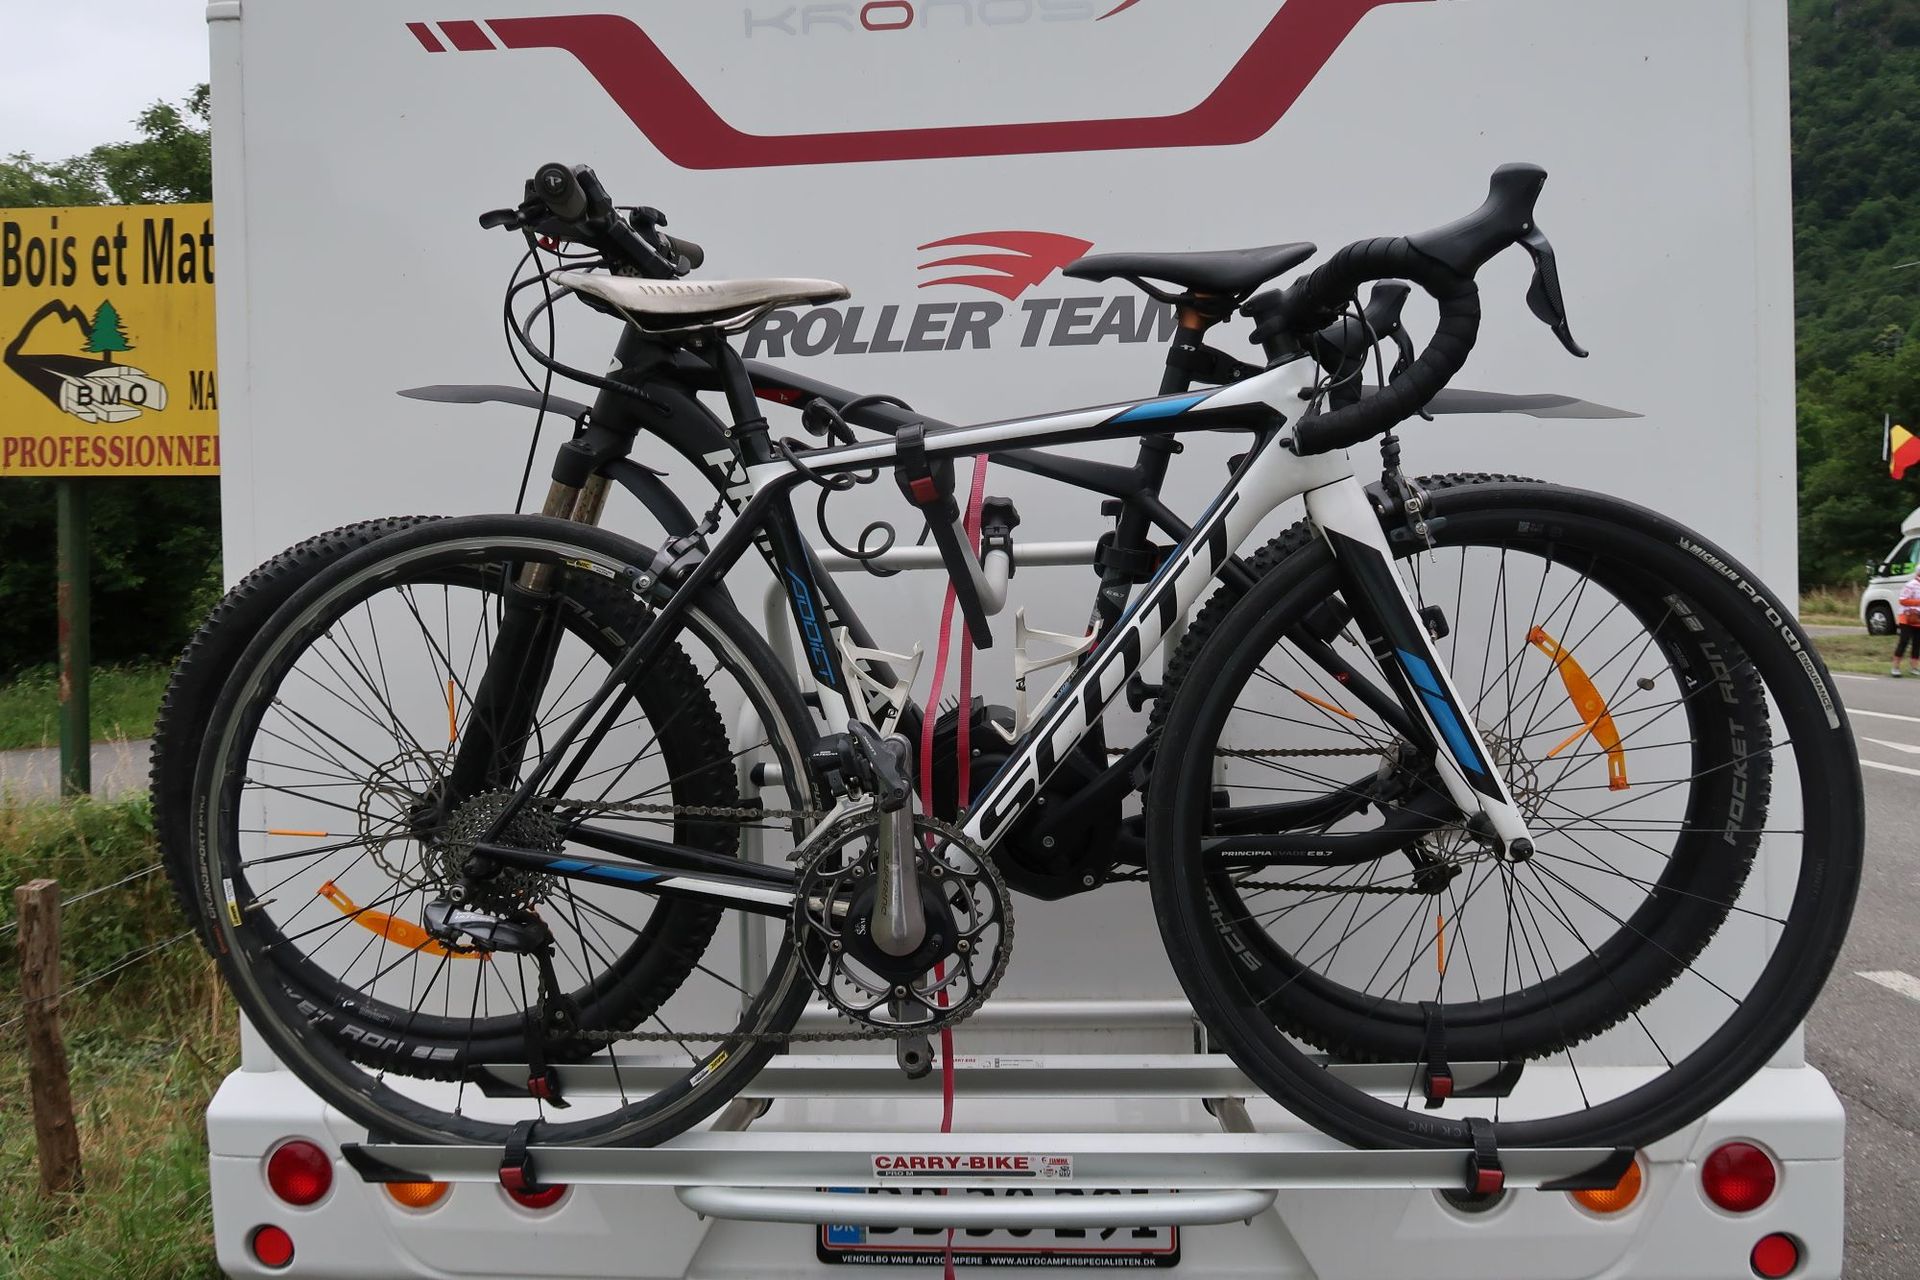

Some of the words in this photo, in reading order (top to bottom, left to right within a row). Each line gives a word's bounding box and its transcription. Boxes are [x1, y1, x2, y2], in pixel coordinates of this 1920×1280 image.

[2, 215, 77, 287] Bois
[91, 221, 127, 286] et
[741, 300, 1004, 359] ROLLER
[76, 382, 147, 406] BMO
[1688, 543, 1740, 582] MICHELIN
[1798, 651, 1834, 711] ENDURANCE
[979, 491, 1240, 841] SCOTT
[1722, 717, 1749, 847] ROCKET
[875, 1156, 1029, 1170] CARRY-BIKE
[841, 1255, 888, 1264] VENDELBO
[890, 1255, 914, 1264] VANS
[916, 1255, 983, 1265] AUTOCMPERE
